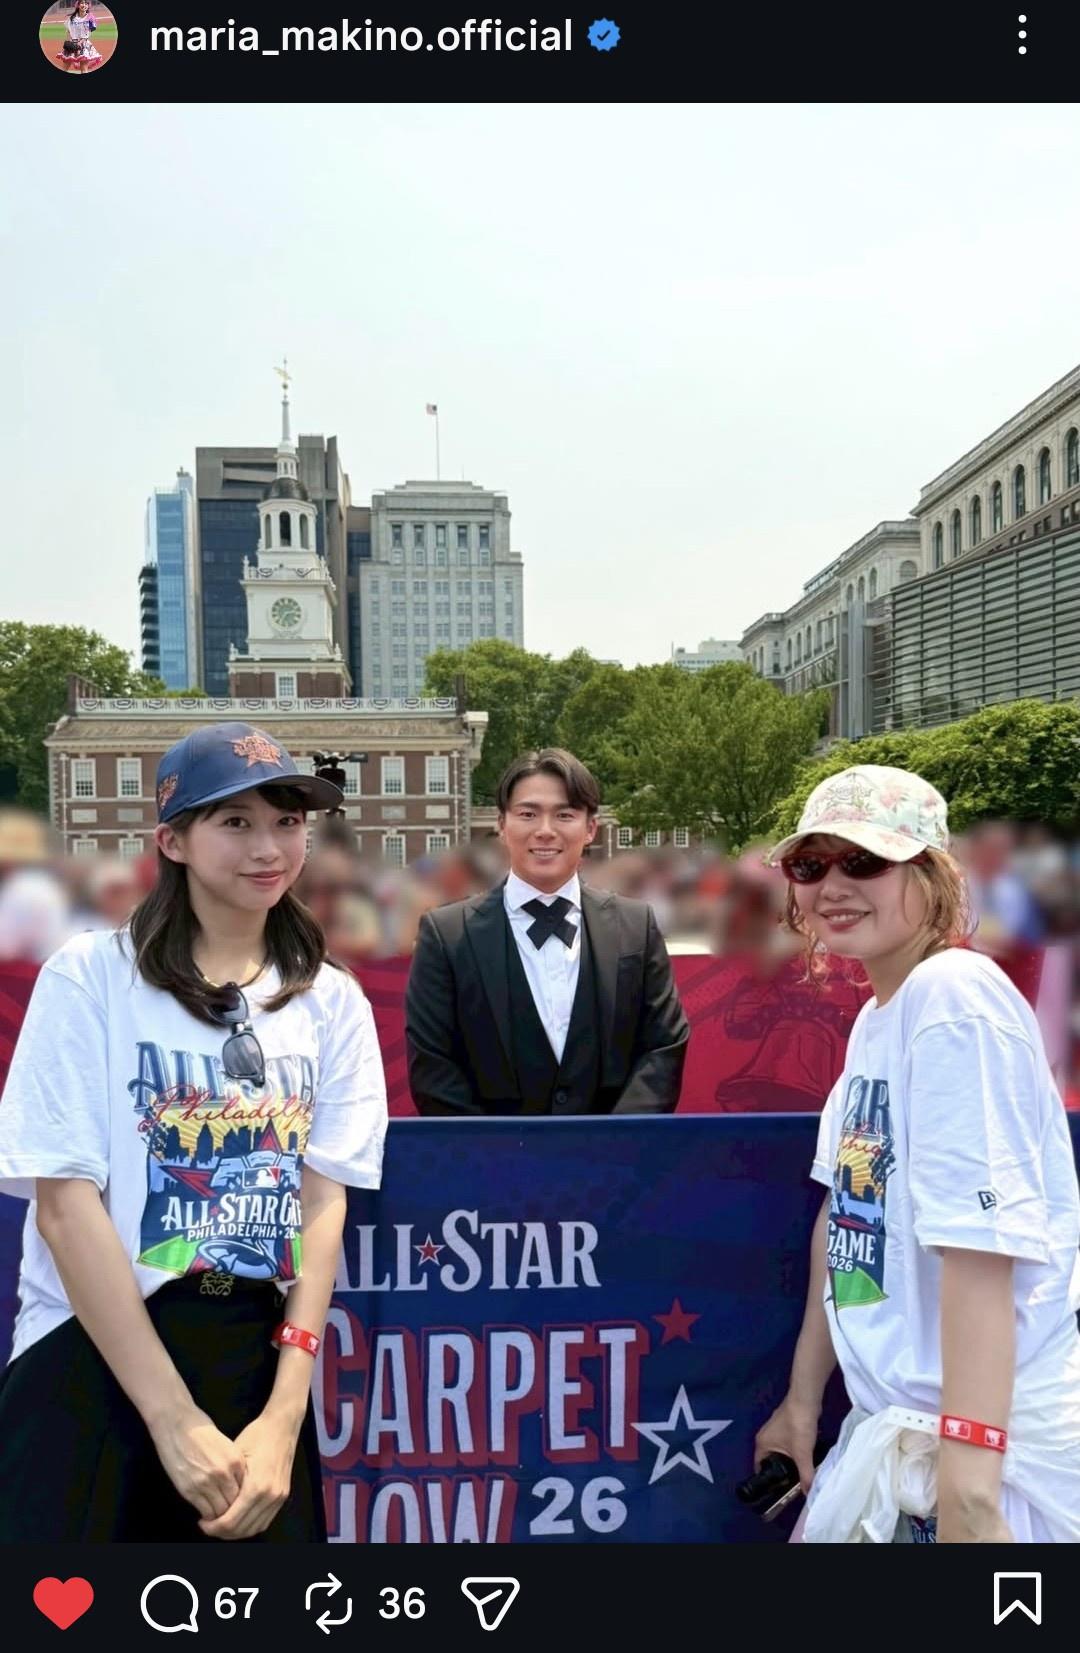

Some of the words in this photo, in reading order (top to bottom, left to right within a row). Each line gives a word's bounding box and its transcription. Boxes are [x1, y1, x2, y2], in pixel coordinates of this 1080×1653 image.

[160, 1196, 213, 1231] ALL
[217, 1192, 279, 1224] STAR
[186, 1223, 277, 1242] PHILADELPHIA
[440, 1209, 601, 1292] STAR
[316, 1304, 640, 1460] CARPET
[530, 1476, 627, 1535] 26
